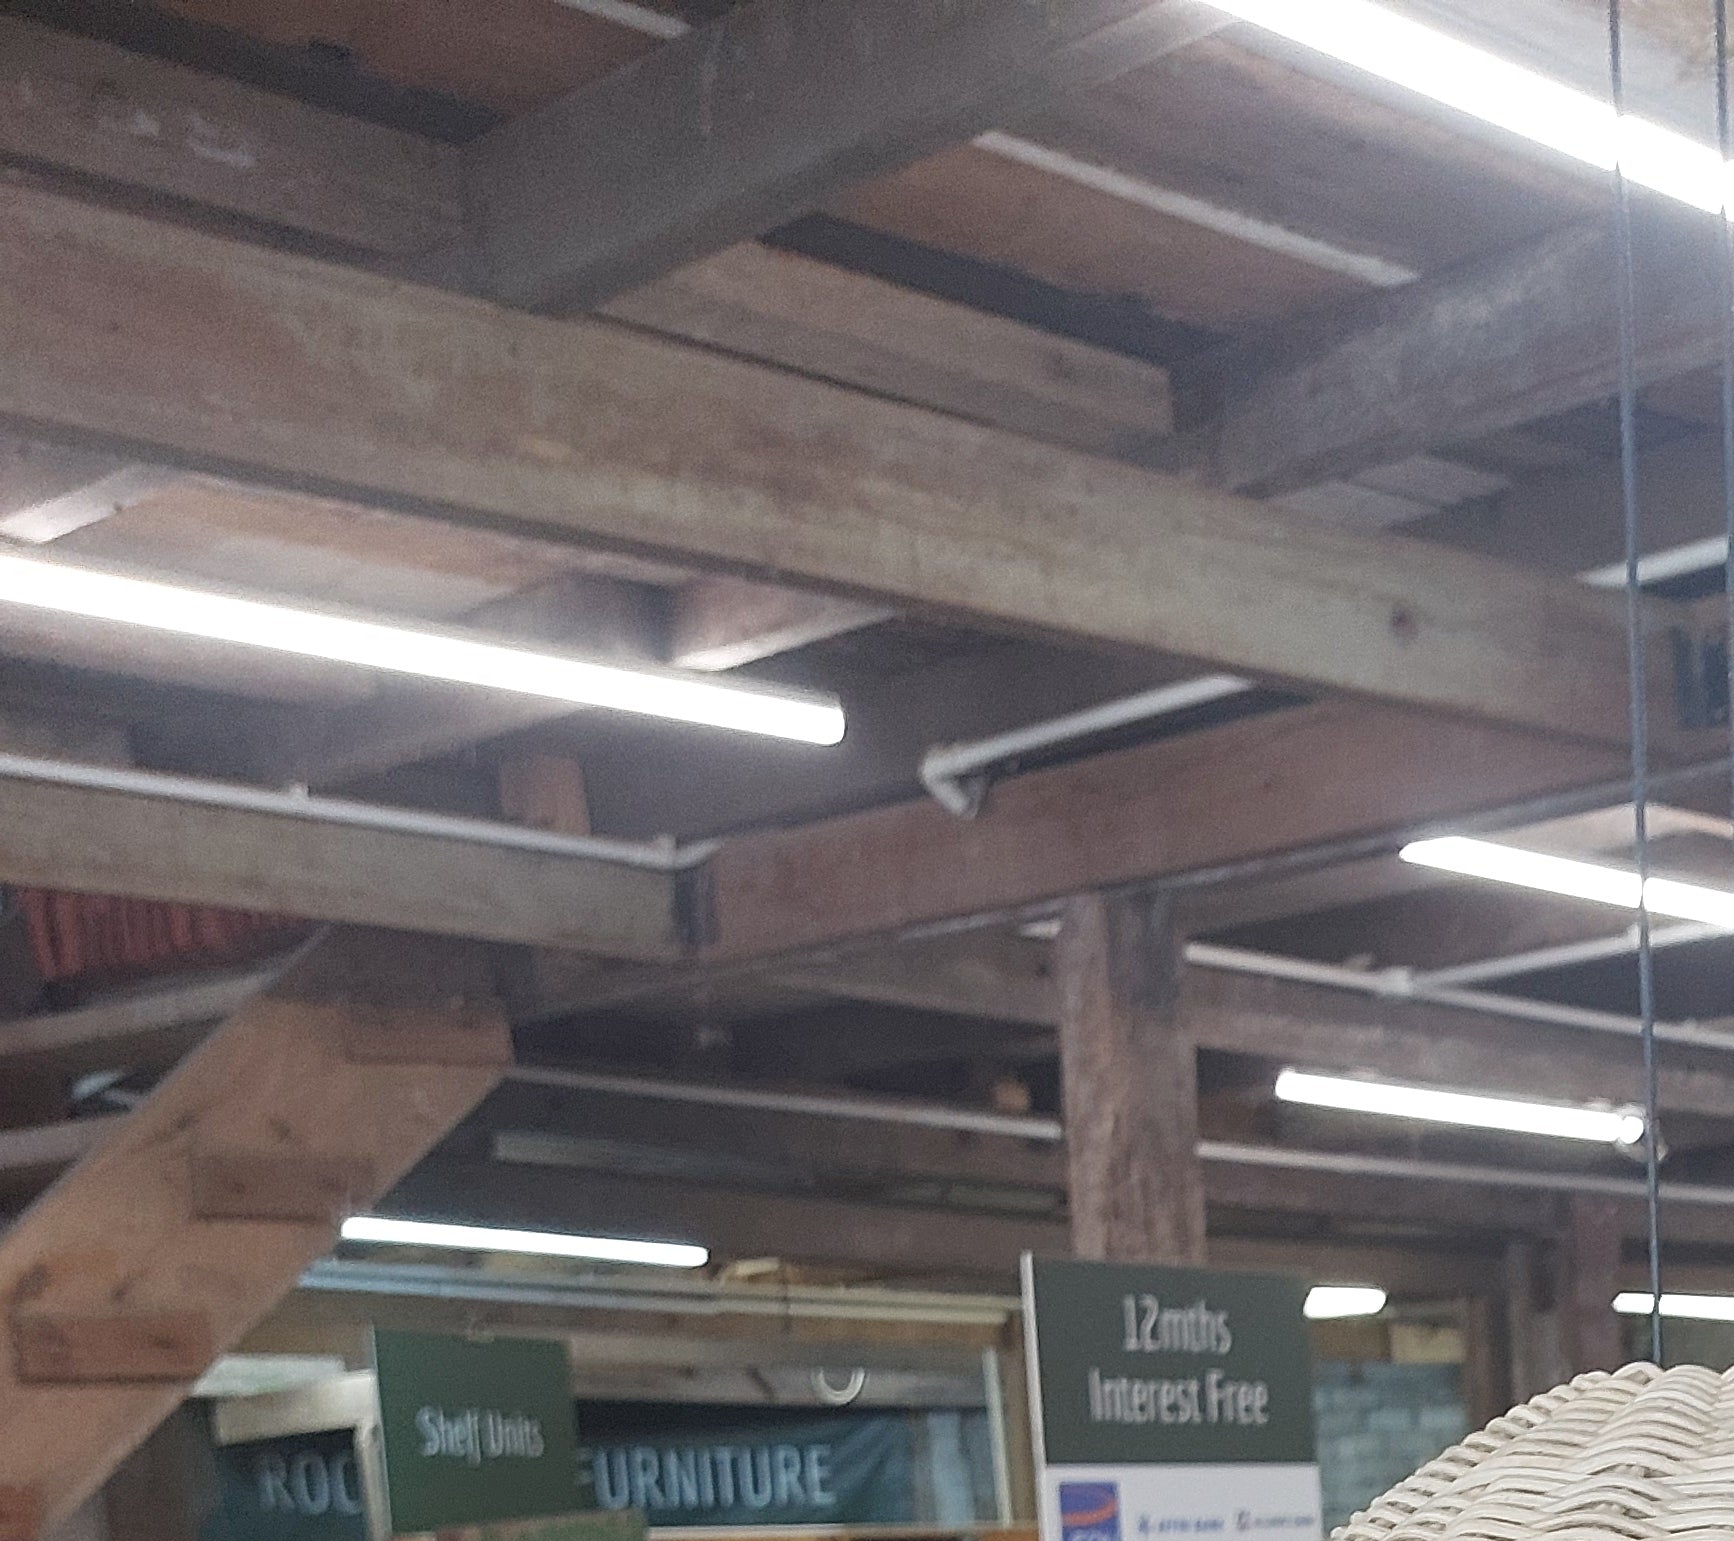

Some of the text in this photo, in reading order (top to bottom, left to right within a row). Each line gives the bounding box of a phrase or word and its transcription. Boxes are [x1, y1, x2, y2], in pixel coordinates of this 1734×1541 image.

[1122, 1294, 1233, 1355] 12mths
[1087, 1366, 1269, 1425] Interest Free
[414, 1404, 545, 1466] Shelf Units
